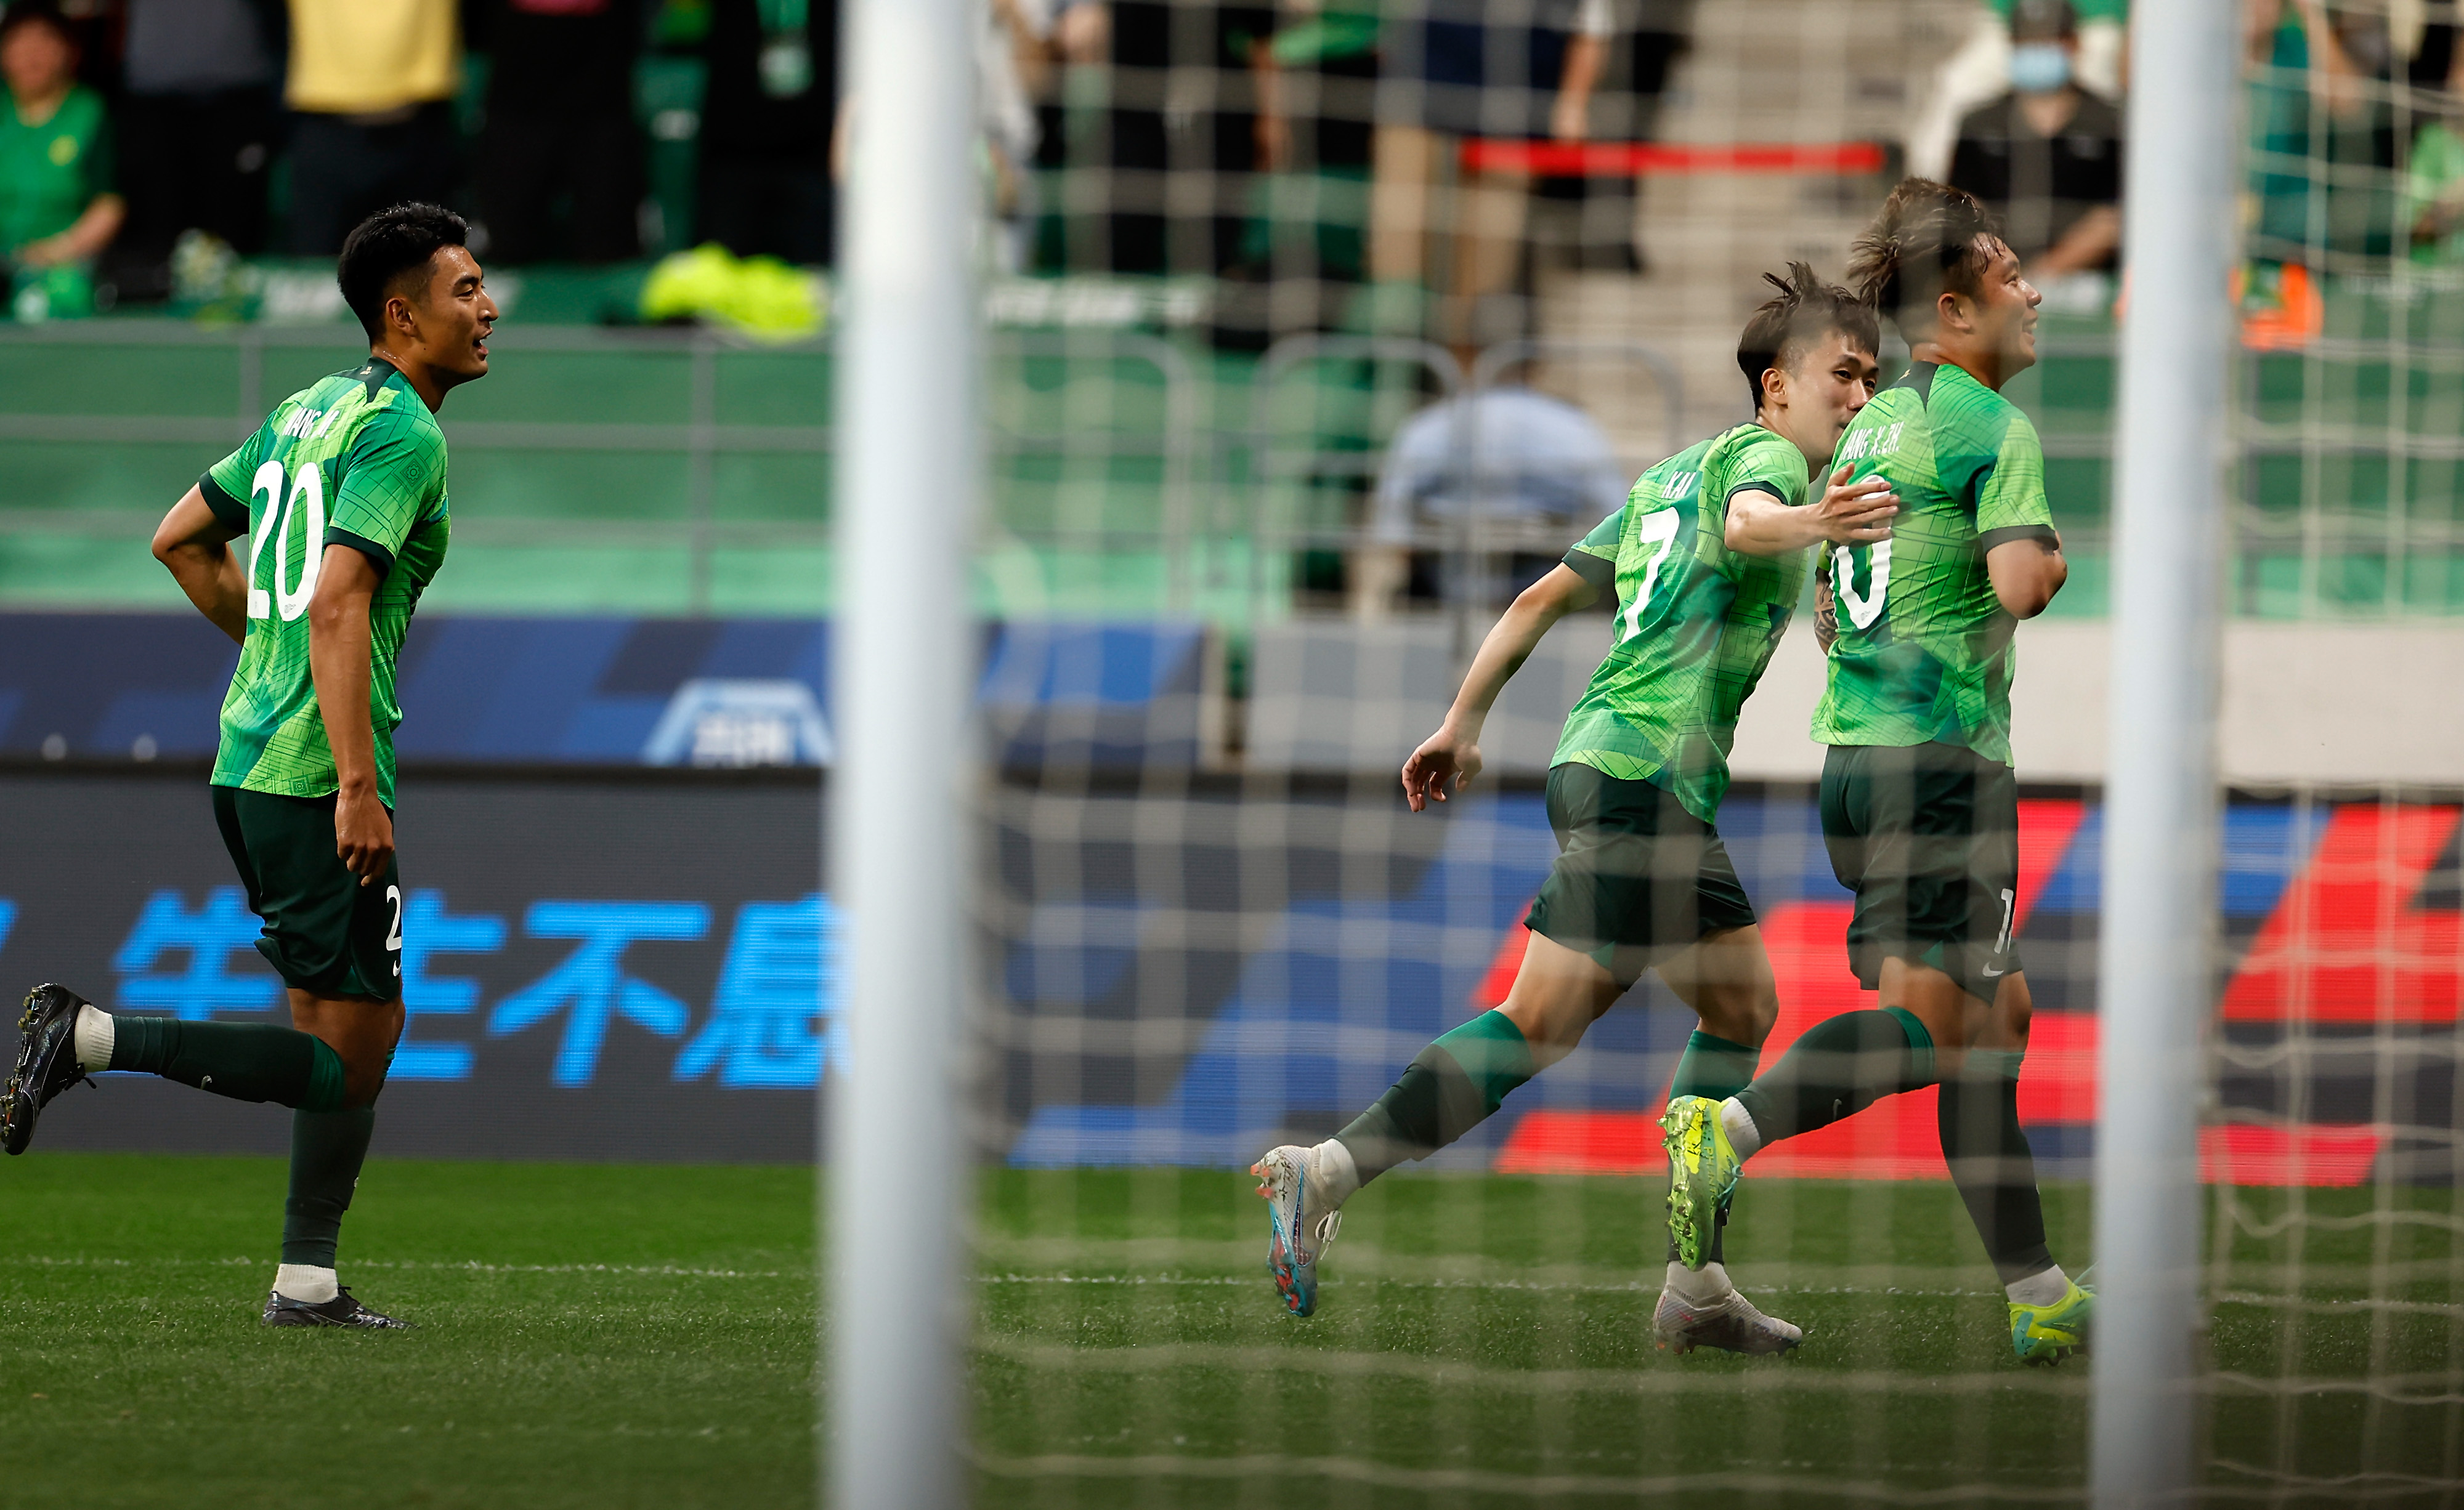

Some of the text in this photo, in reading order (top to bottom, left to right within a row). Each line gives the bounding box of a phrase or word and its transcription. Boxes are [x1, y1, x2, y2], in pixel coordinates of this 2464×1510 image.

[1838, 427, 1873, 461] ANG
[247, 459, 325, 623] 20
[1620, 506, 1680, 644] 7
